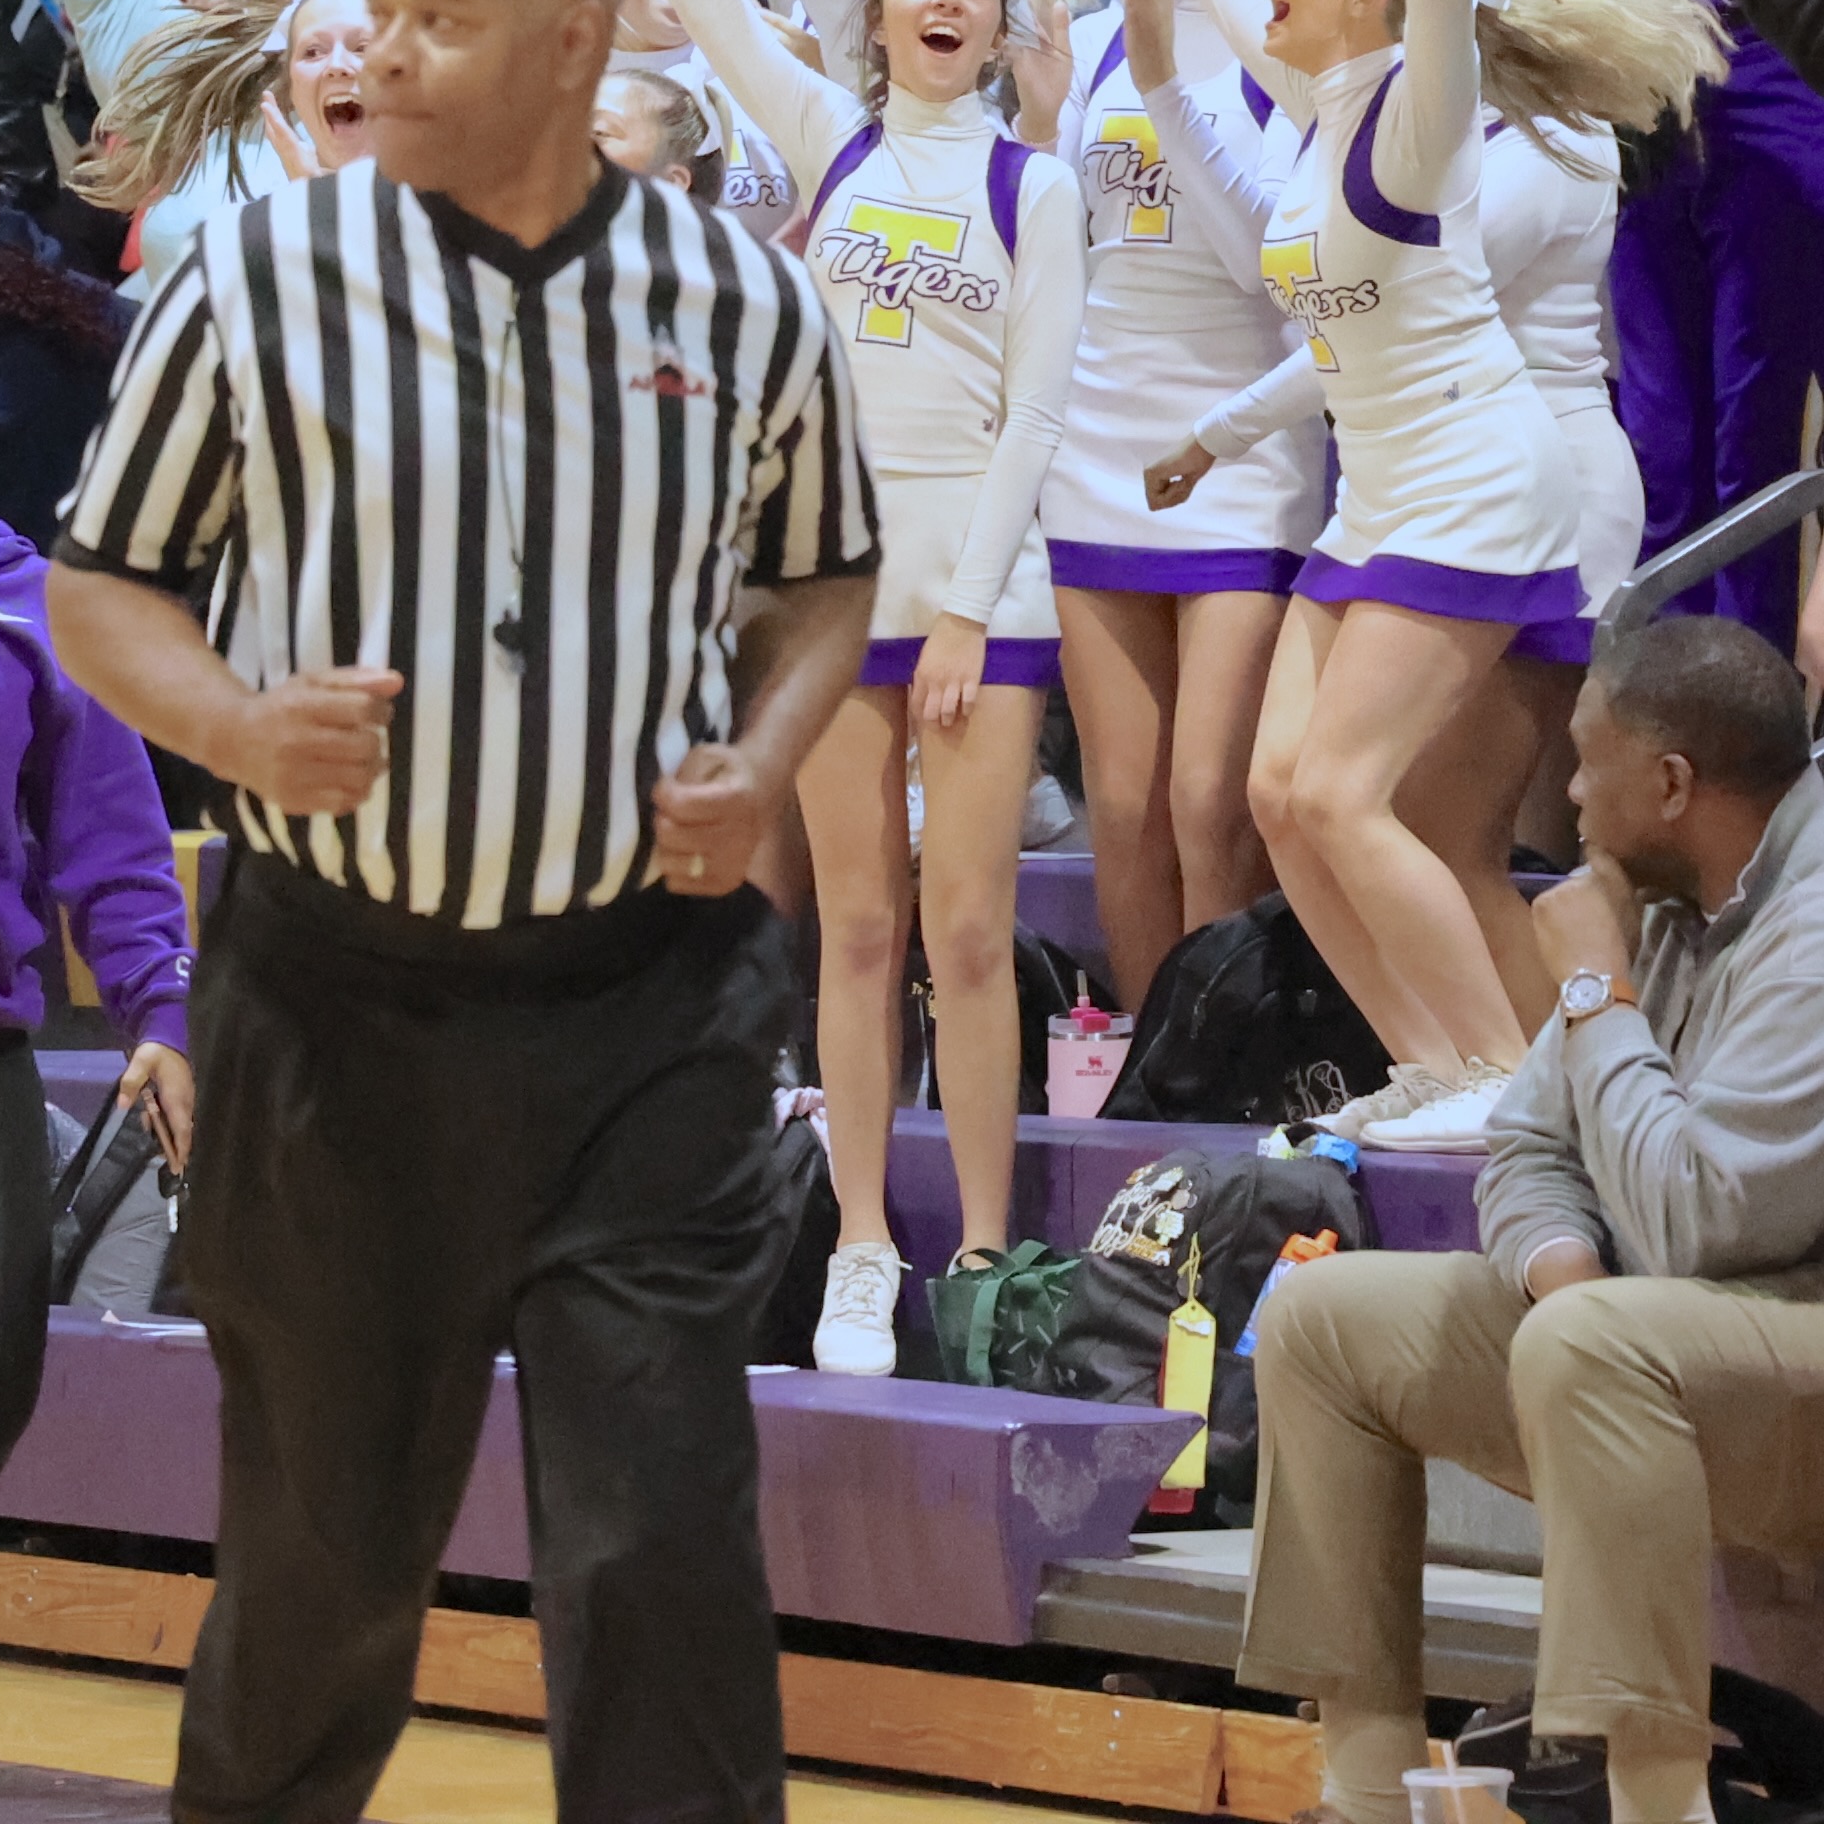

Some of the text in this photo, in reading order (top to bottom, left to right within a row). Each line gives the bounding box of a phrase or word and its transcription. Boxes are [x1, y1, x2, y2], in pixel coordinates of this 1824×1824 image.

[722, 174, 790, 207] ers
[1083, 141, 1180, 209] Tig
[815, 228, 1000, 312] Tigers
